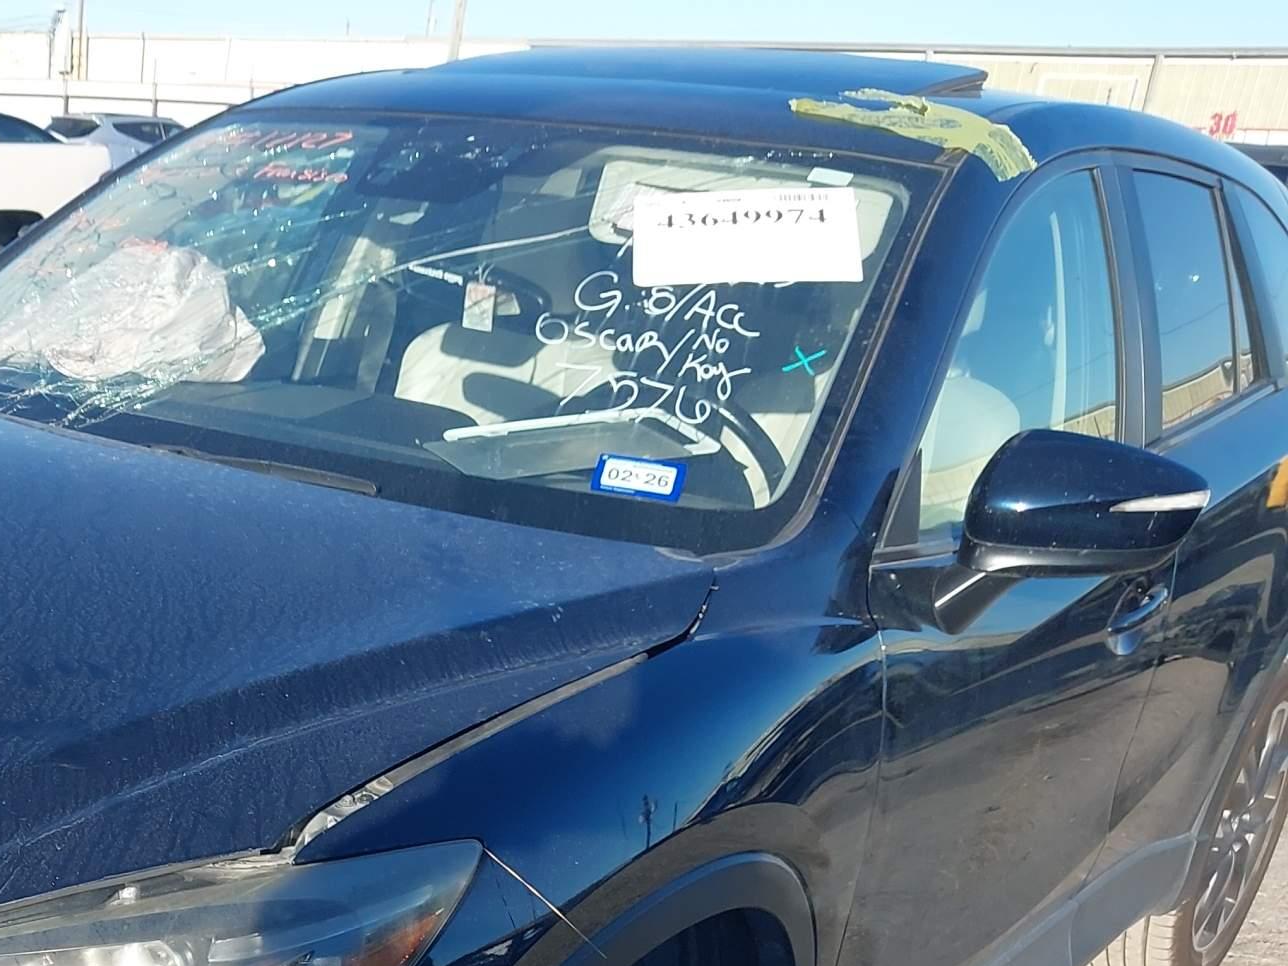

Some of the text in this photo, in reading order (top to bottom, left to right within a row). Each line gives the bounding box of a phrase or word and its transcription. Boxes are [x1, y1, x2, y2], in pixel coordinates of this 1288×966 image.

[1208, 111, 1238, 136] 30
[657, 207, 829, 229] 43649974
[555, 361, 711, 424] 7576
